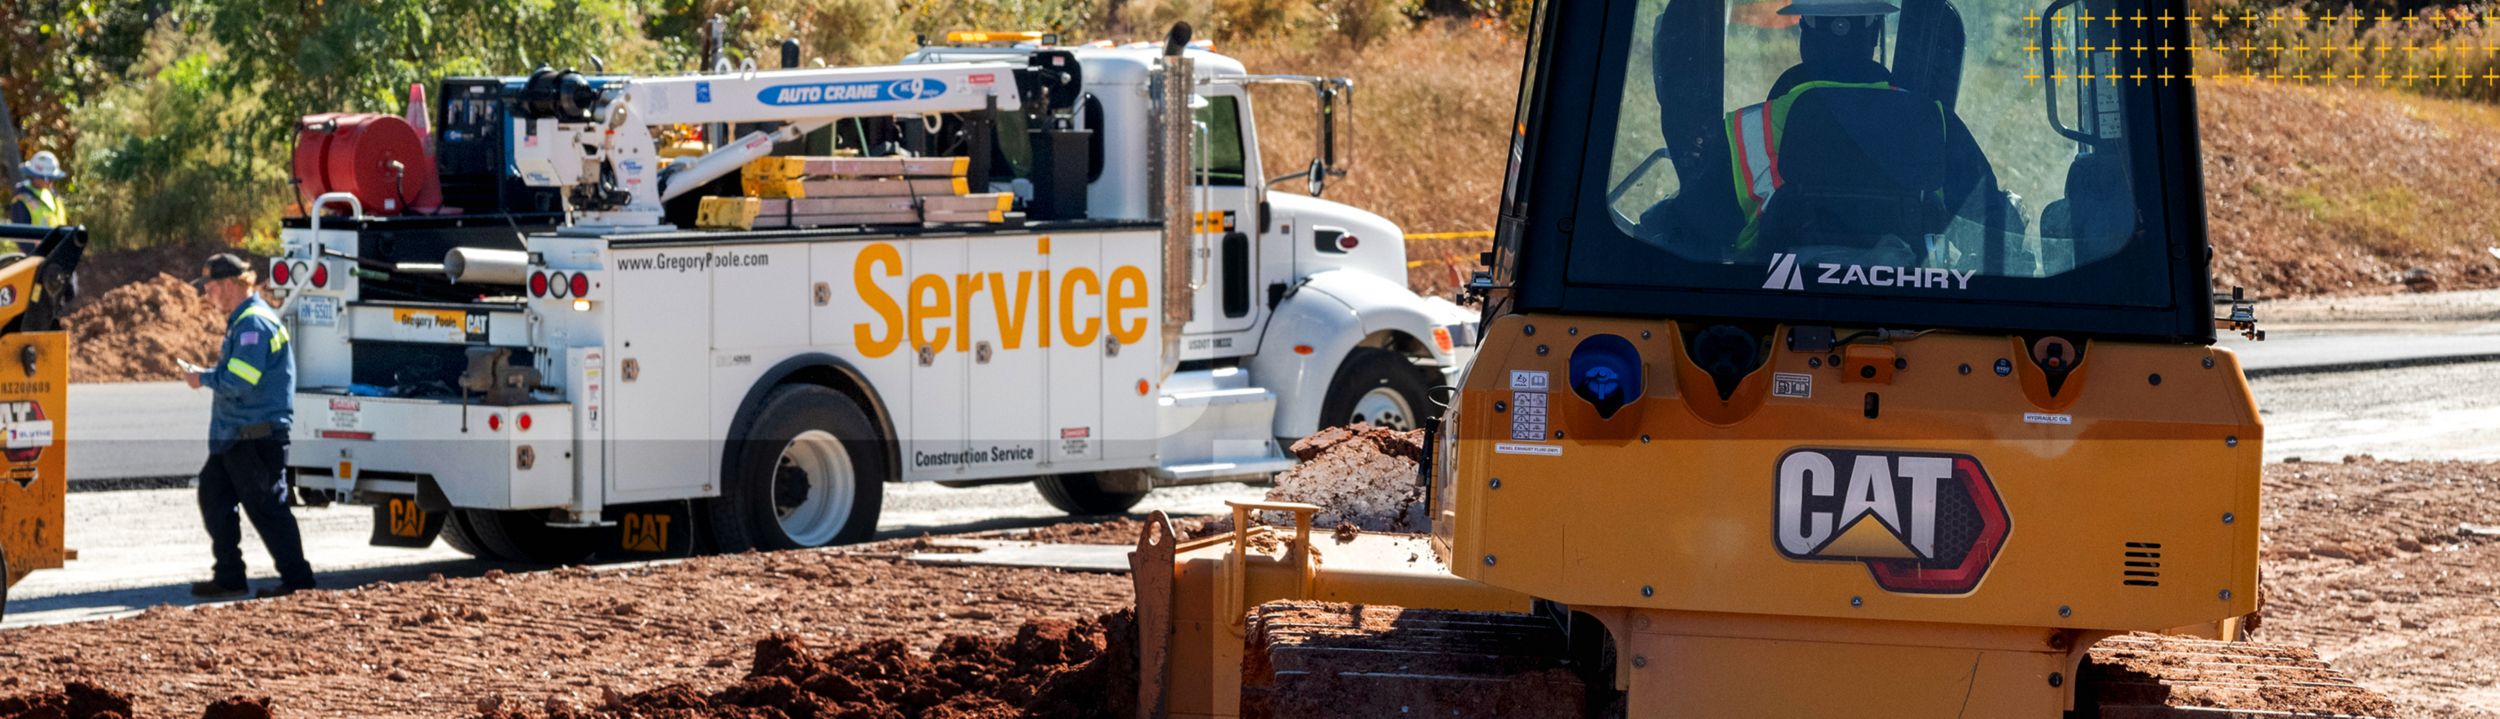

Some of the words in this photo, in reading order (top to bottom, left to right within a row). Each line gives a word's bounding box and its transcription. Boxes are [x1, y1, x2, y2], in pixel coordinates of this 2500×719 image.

[777, 86, 821, 103] AUTO
[824, 84, 878, 100] CRANE
[911, 78, 924, 101] 9
[617, 251, 769, 272] www.GregoryPoole.com
[1818, 262, 1977, 290] ZACHRY
[853, 235, 1149, 358] Service
[402, 313, 433, 329] Gregory
[435, 315, 456, 328] Poole
[467, 314, 487, 333] CAT
[915, 449, 988, 467] Construction
[991, 445, 1034, 462] Service
[1778, 450, 1953, 559] CAT
[622, 511, 671, 552] CAT
